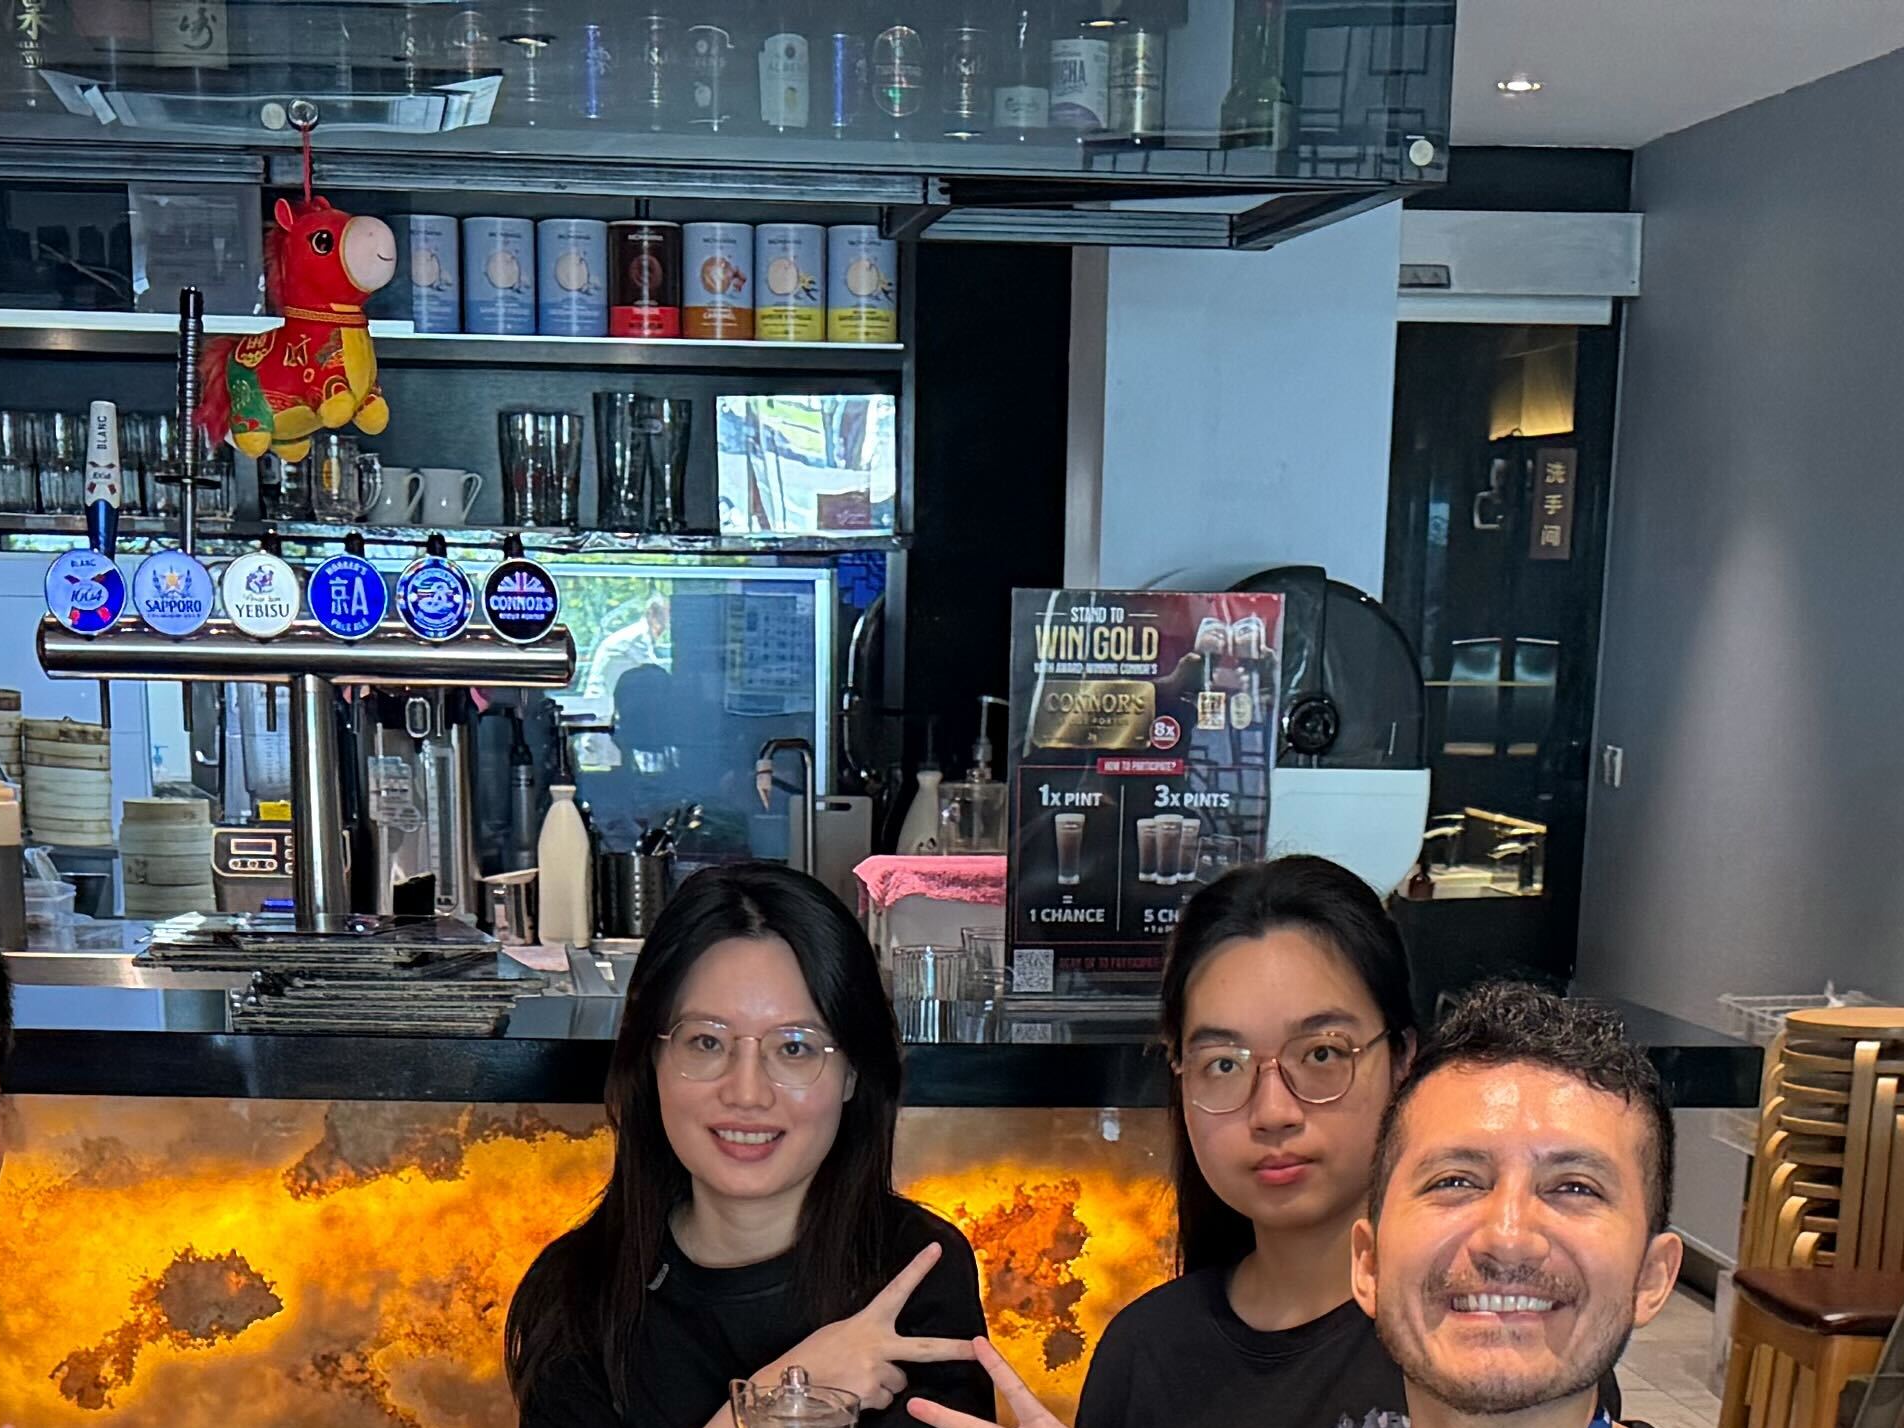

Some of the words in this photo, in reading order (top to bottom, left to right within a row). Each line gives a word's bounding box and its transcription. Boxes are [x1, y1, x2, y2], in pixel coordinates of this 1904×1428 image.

[96, 415, 108, 450] BLANC
[146, 599, 202, 614] SAPPORO
[234, 602, 291, 619] YEBISU
[1070, 607, 1107, 624] STAND
[1110, 607, 1125, 624] TO
[1035, 625, 1085, 661] WIN
[1093, 626, 1159, 661] GOLD
[1046, 693, 1145, 713] CONNOR'S
[1064, 792, 1103, 806] PINT
[1183, 792, 1231, 808] PINTS
[1029, 909, 1037, 923] 1
[1041, 908, 1105, 923] CHANCE
[1144, 908, 1154, 923] 5
